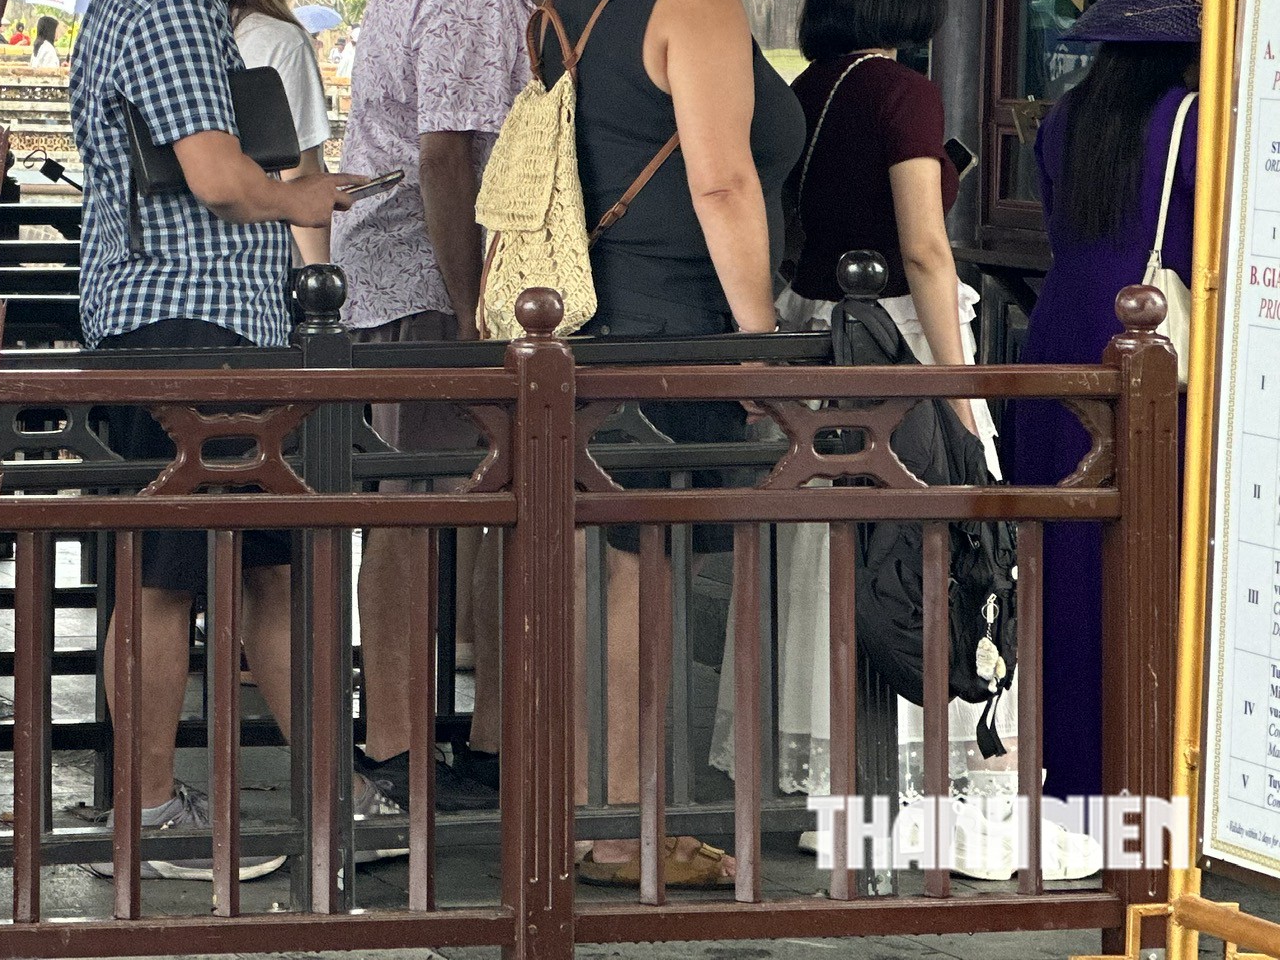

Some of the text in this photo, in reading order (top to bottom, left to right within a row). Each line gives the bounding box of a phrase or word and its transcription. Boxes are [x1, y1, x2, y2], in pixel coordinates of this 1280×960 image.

[1250, 265, 1260, 286] B.
[1253, 483, 1261, 499] II
[1248, 588, 1259, 605] III
[1244, 701, 1255, 716] IV
[1242, 773, 1250, 788] V
